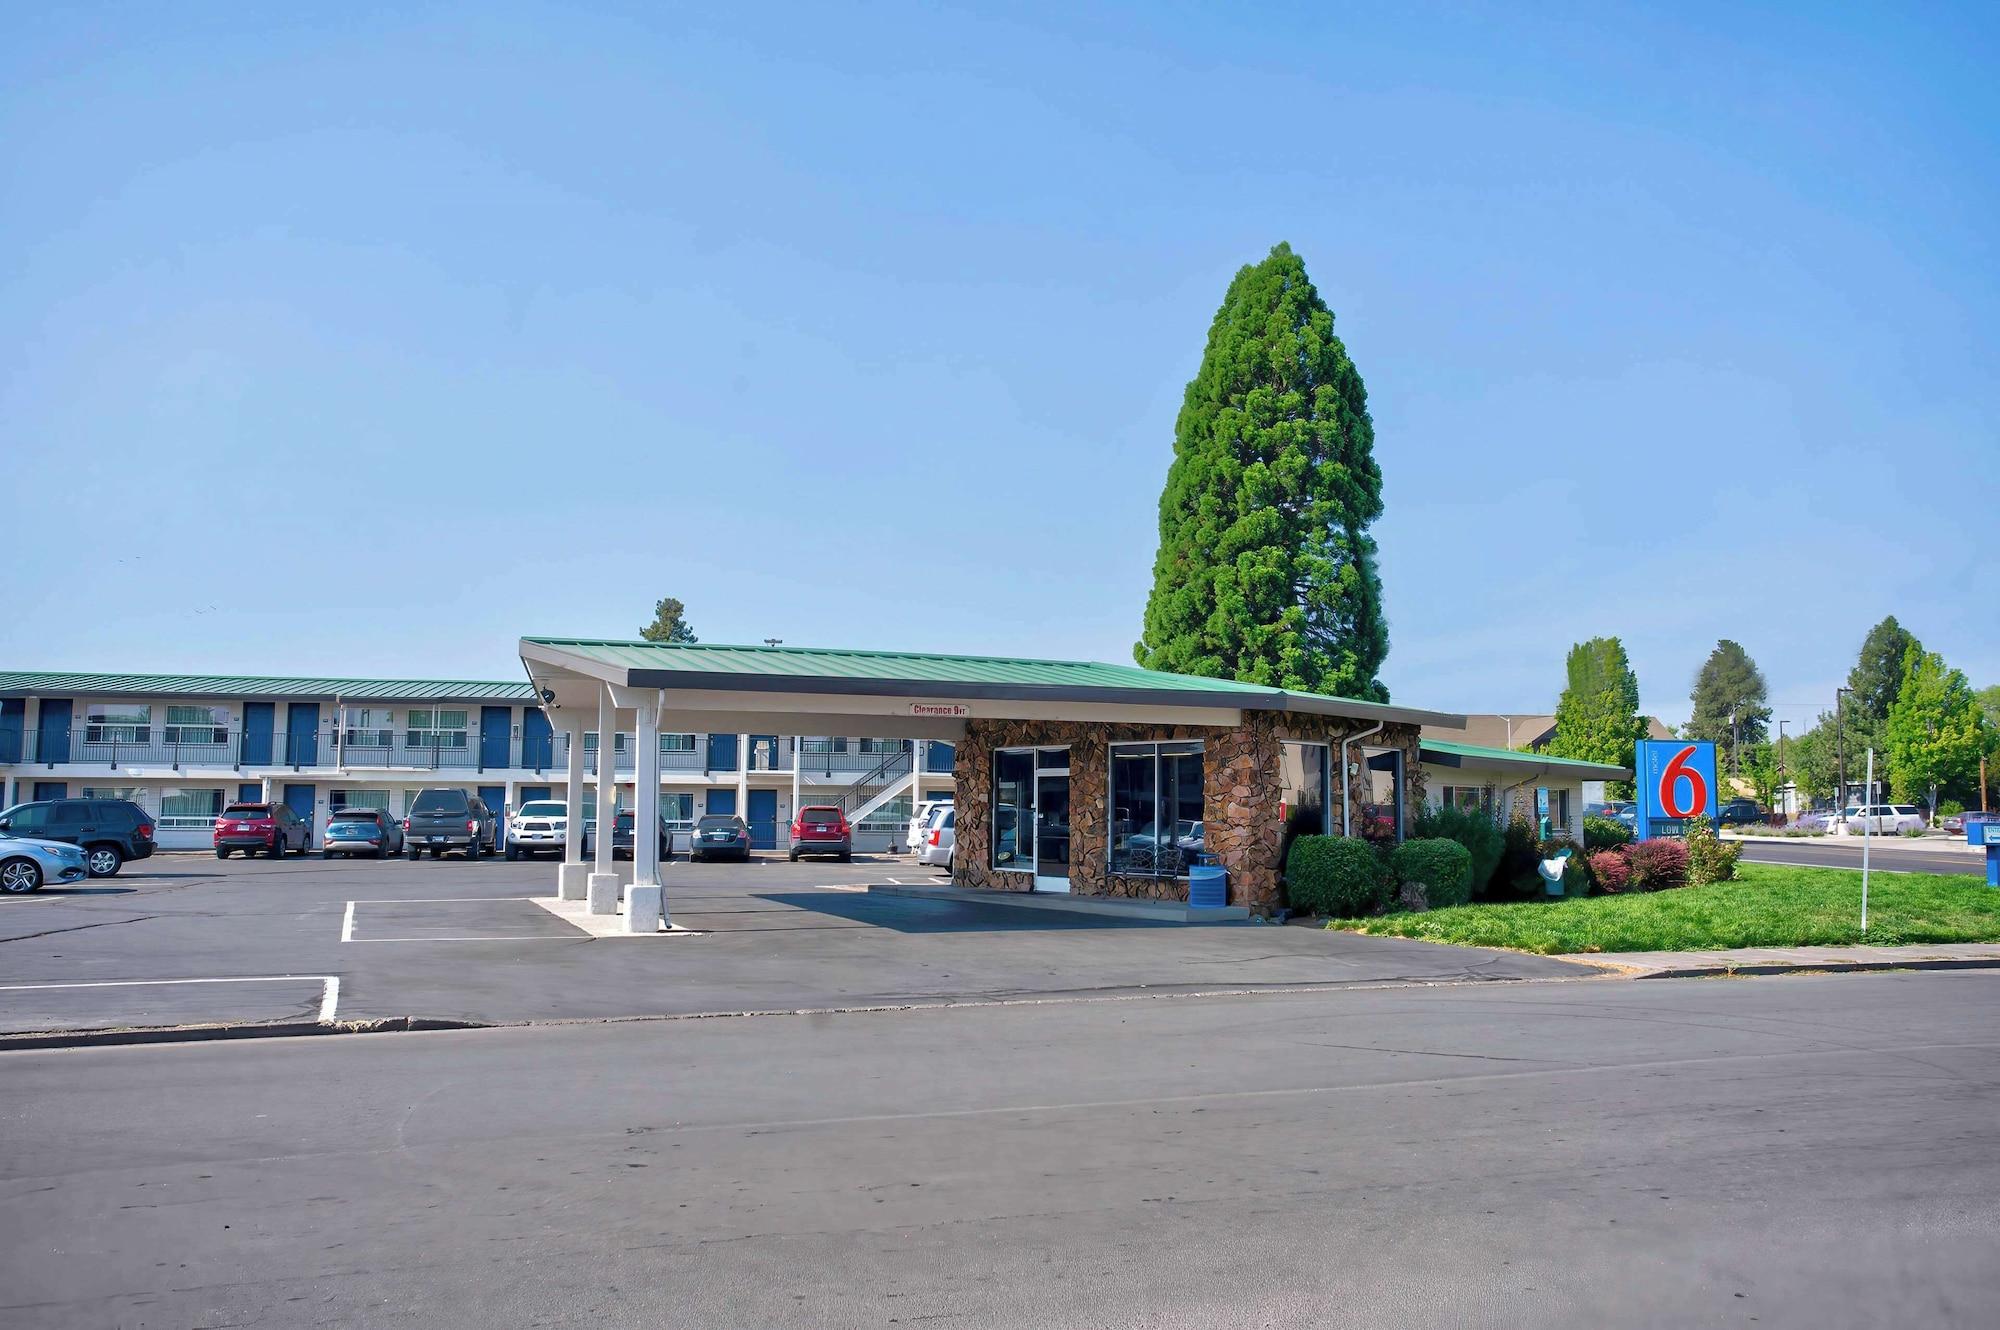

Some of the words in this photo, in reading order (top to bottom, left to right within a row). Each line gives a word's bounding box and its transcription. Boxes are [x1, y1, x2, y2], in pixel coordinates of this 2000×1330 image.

[914, 705, 952, 715] Clearance
[1659, 745, 1707, 819] 6
[1661, 825, 1679, 834] LOW
